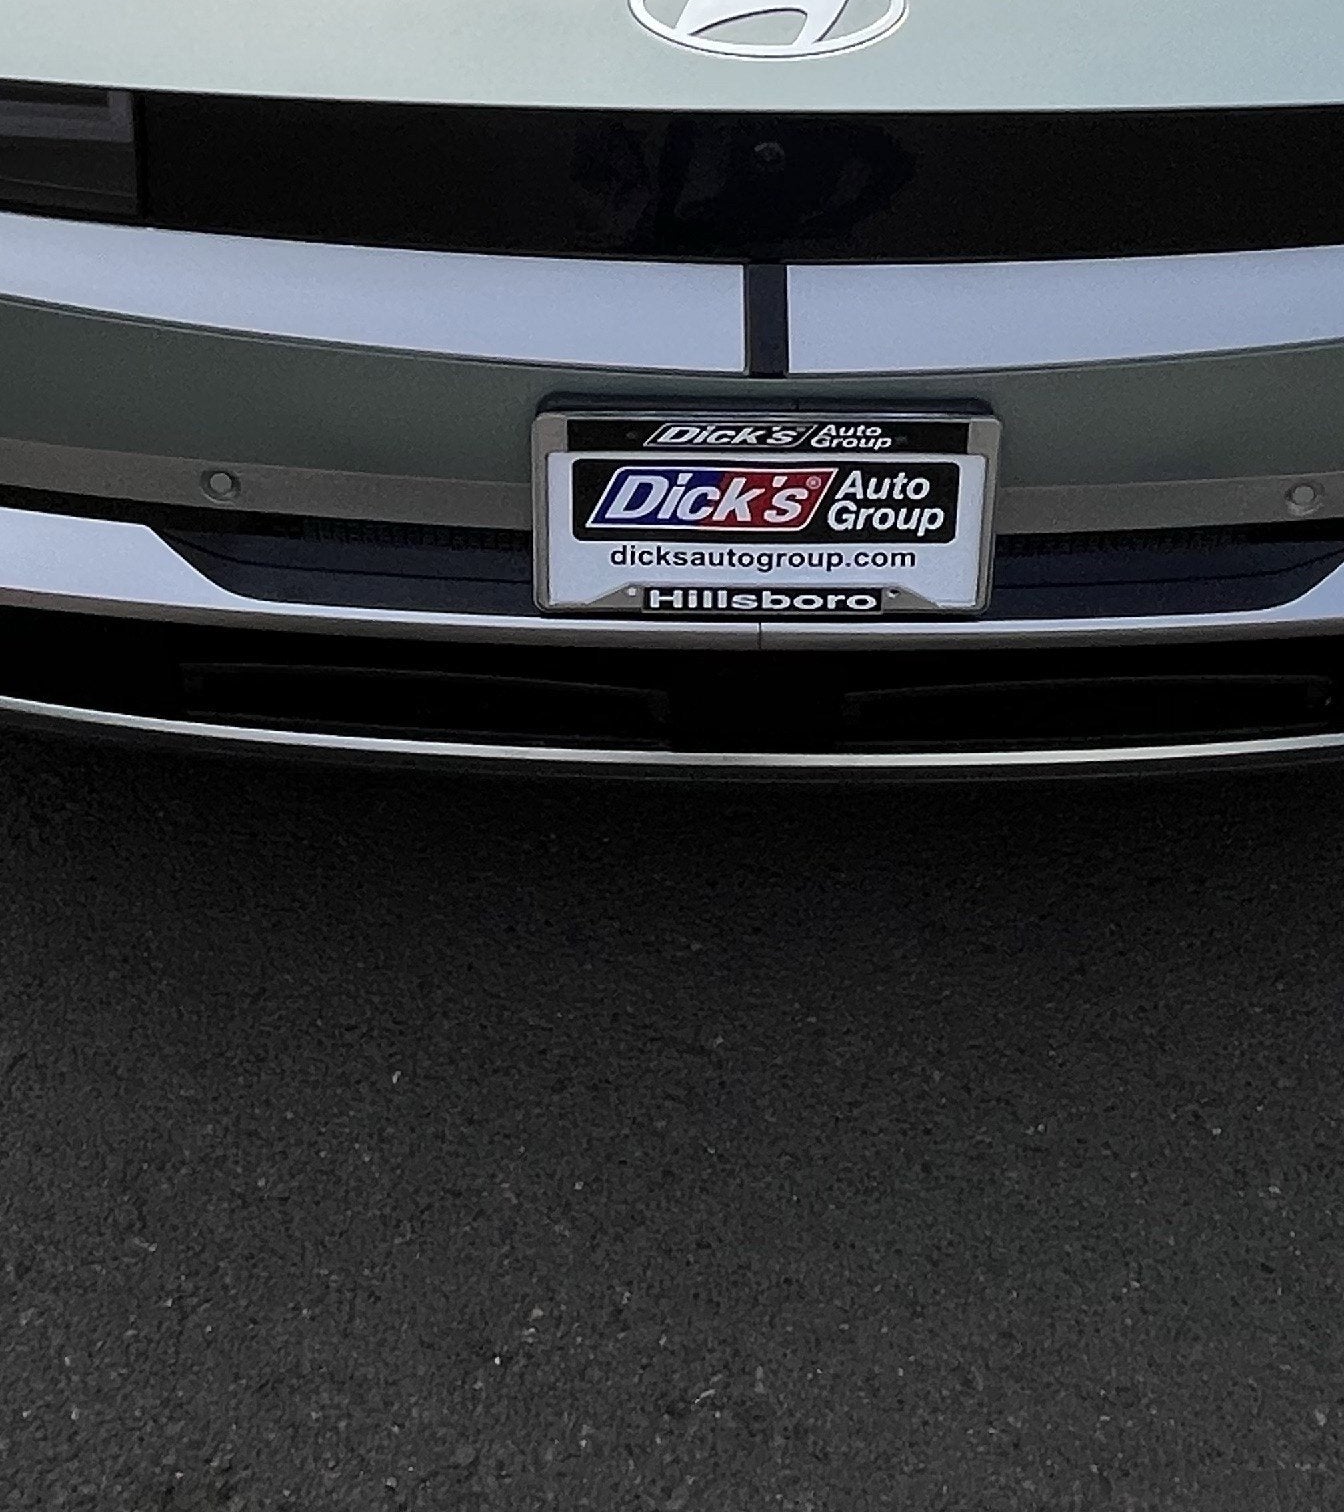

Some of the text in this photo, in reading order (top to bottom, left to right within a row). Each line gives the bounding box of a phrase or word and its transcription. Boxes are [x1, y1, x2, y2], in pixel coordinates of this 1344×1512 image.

[657, 424, 882, 445] Dick's Auto
[811, 436, 892, 450] Group
[605, 470, 931, 523] Dick's Auto
[827, 500, 945, 537] Group
[610, 545, 917, 572] dicksautogroup.com
[649, 589, 878, 610] Hillsboro
